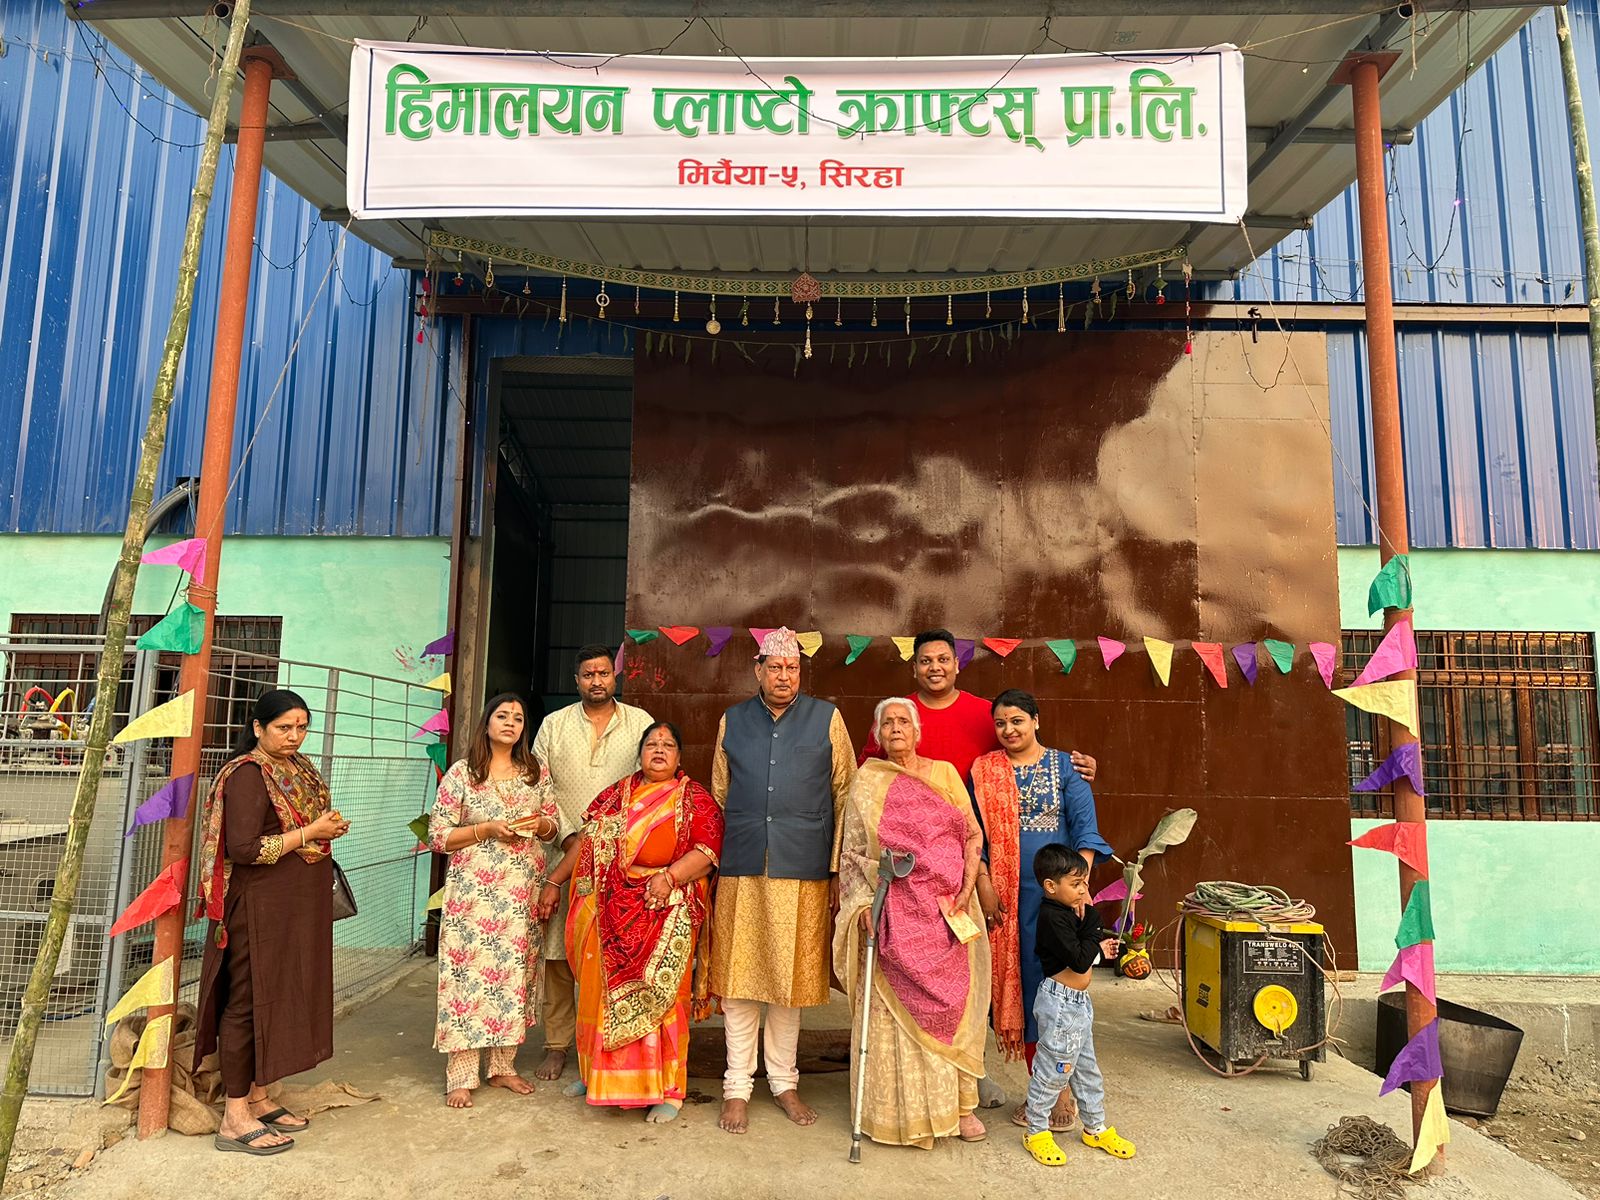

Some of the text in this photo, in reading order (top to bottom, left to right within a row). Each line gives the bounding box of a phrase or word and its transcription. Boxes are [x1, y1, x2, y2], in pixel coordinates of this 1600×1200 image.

[385, 63, 629, 141] हिमालयन
[652, 76, 814, 138] प्लाष्टो
[836, 87, 1045, 151] क्राफ्टस्
[819, 159, 905, 188] सिरहा
